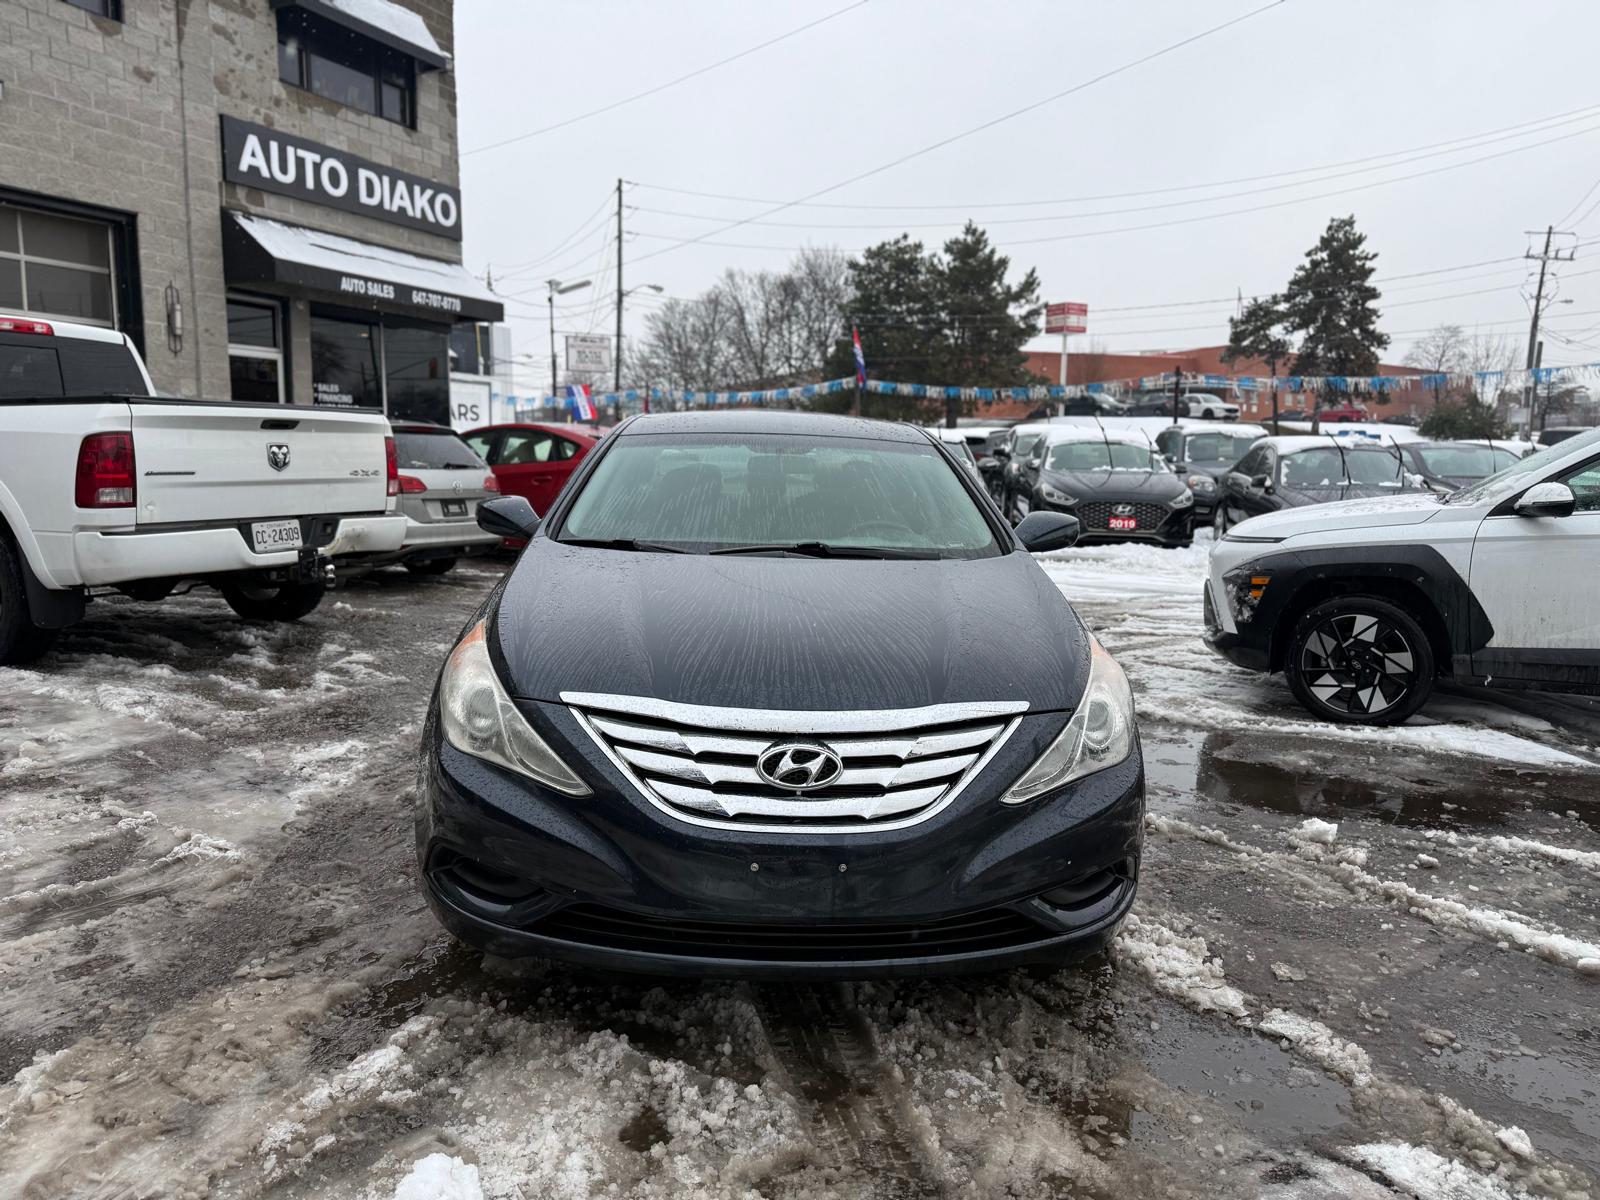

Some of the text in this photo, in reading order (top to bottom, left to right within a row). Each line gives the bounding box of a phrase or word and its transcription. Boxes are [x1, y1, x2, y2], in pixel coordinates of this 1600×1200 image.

[238, 133, 457, 227] AUTO DIAKO
[340, 276, 395, 299] AUTO SALES
[318, 383, 339, 393] SALES
[1109, 519, 1136, 529] 2019
[255, 527, 299, 545] CC 24309
